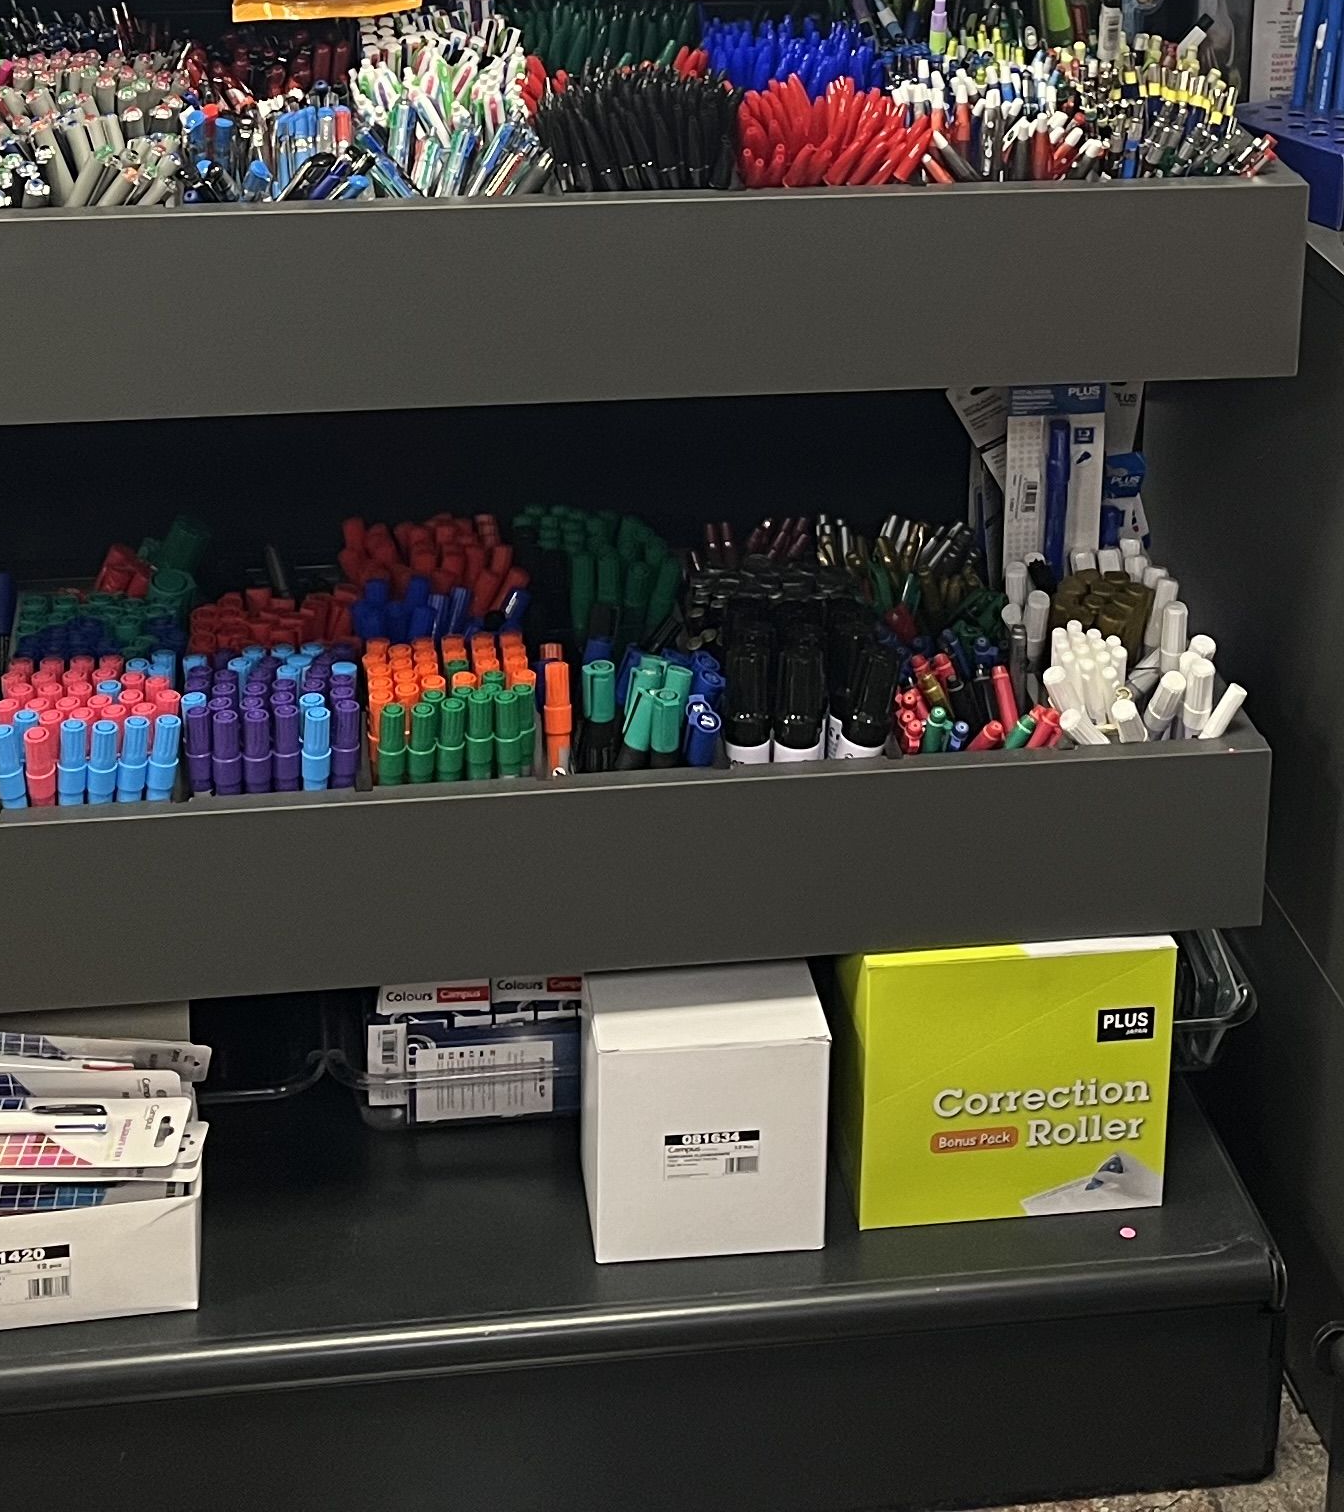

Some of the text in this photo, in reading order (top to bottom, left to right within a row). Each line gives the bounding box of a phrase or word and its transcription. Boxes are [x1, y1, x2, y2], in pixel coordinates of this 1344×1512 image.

[1067, 384, 1101, 399] PLUS
[1110, 473, 1140, 487] PLUS
[496, 979, 544, 990] Colours
[386, 988, 481, 1003] Colours Campus
[1103, 1011, 1149, 1030] PLUS
[933, 1077, 1150, 1118] Correction
[681, 1131, 740, 1145] 081634
[1025, 1114, 1144, 1148] Roller
[938, 1131, 1011, 1149] Bonus Pack
[667, 1146, 701, 1154] Campus
